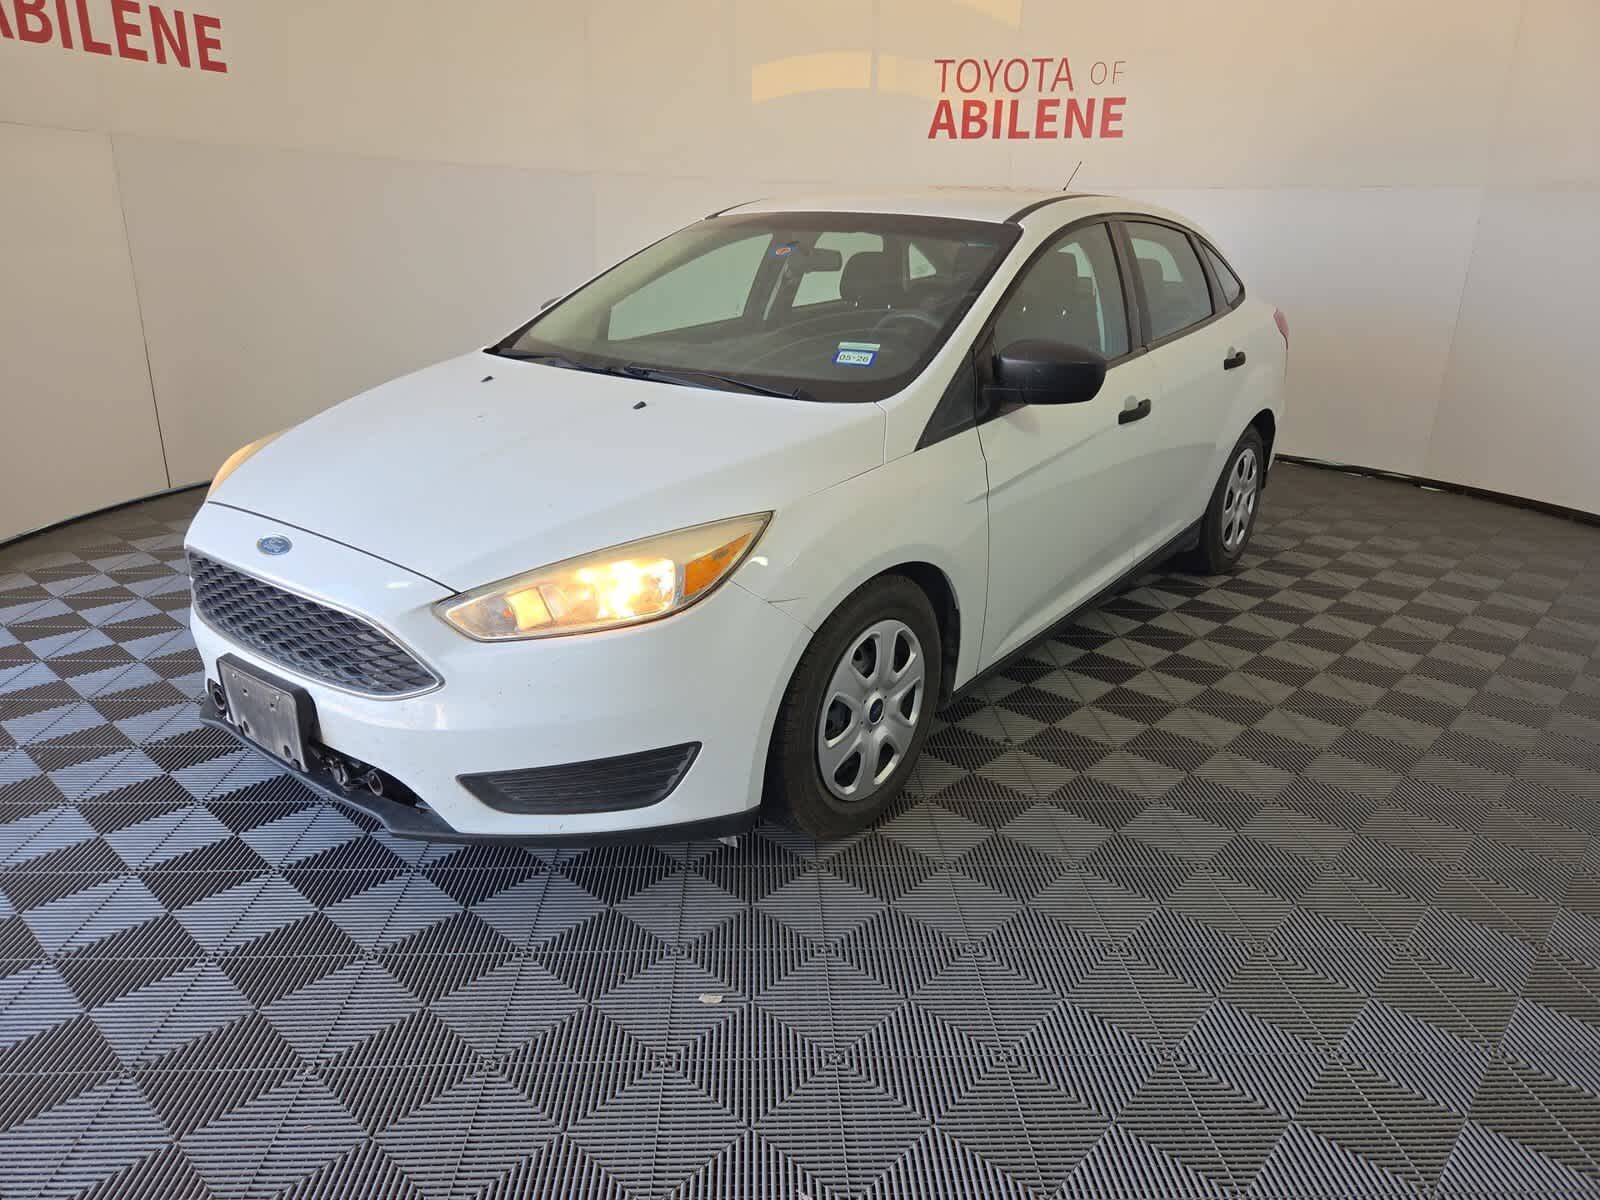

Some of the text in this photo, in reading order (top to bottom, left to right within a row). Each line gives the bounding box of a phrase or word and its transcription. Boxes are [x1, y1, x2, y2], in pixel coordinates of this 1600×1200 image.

[934, 57, 1127, 93] TOYOTA OF
[928, 96, 1127, 139] ABILENE
